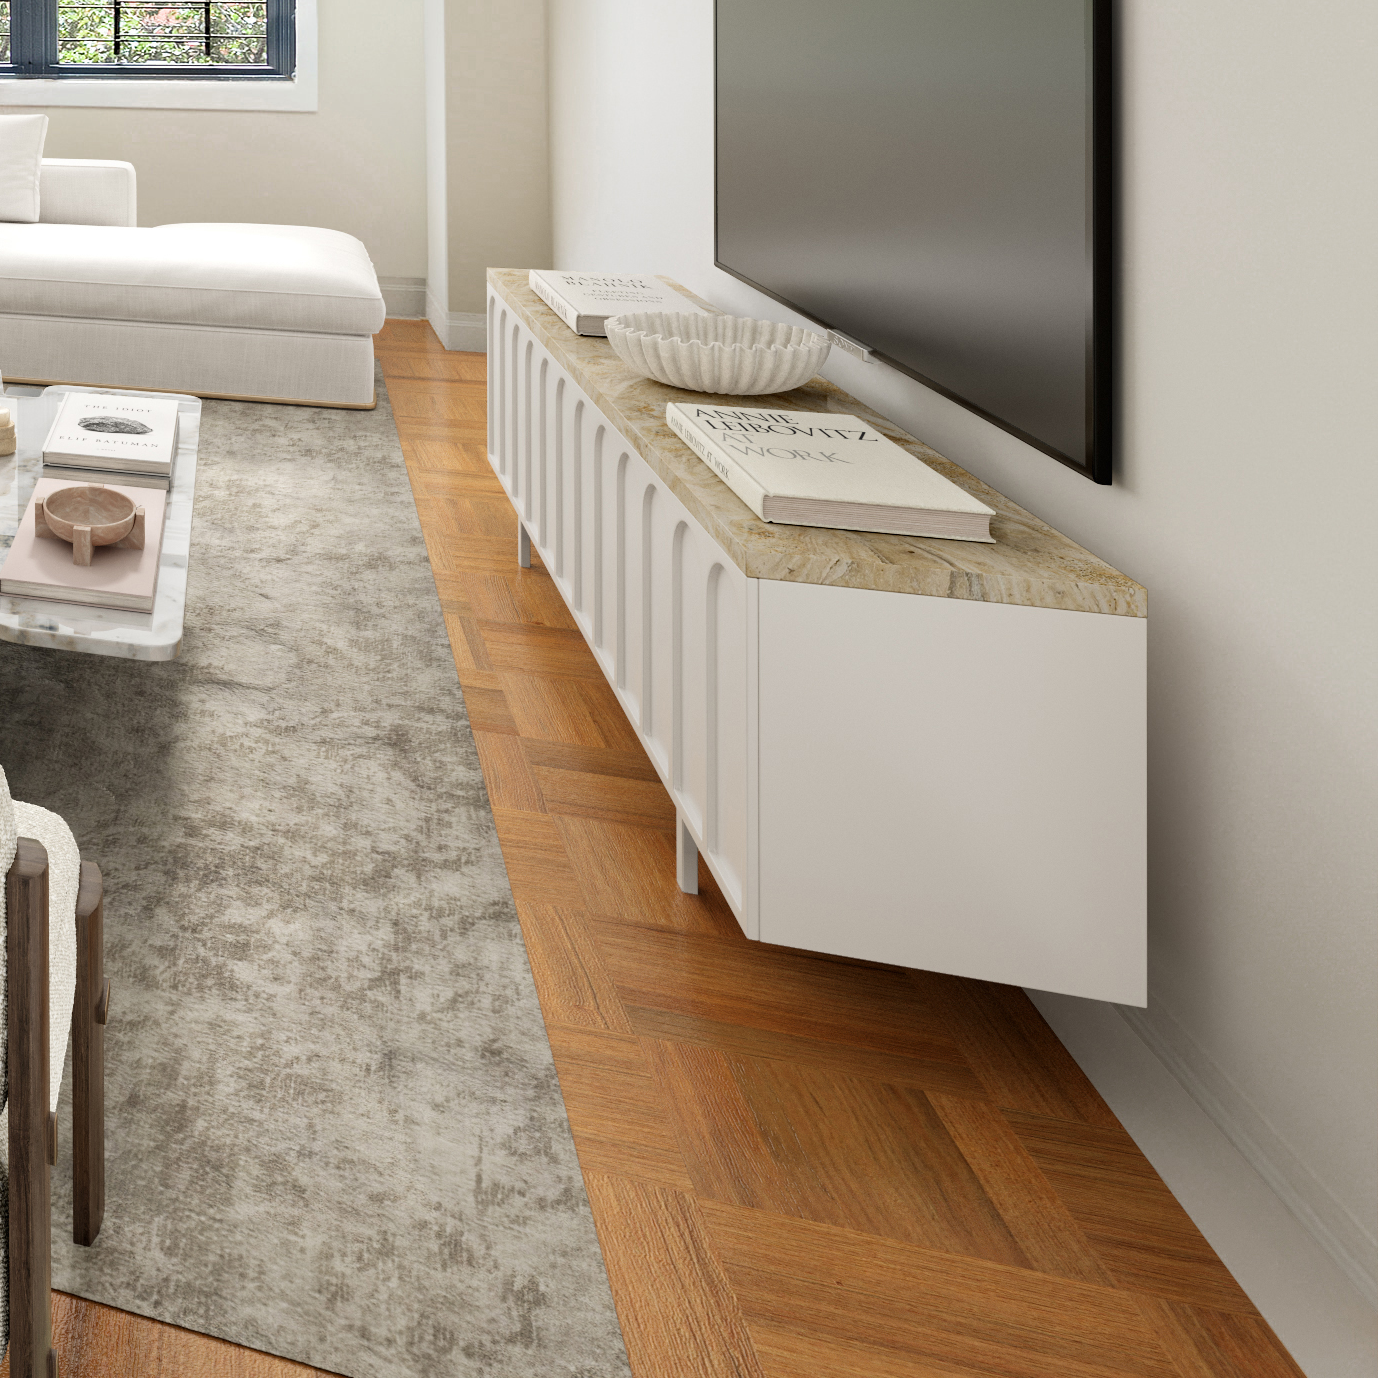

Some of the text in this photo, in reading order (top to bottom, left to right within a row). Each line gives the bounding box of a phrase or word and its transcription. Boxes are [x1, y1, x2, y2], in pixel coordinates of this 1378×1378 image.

[696, 408, 799, 424] ANNIE
[704, 419, 879, 442] LEIBOVITZ
[721, 431, 757, 444] AT
[95, 438, 159, 448] BATUMAN
[684, 428, 706, 457] LEIBOVITZ
[706, 451, 713, 463] AT
[714, 457, 730, 481] WORK
[728, 444, 855, 464] WORK
